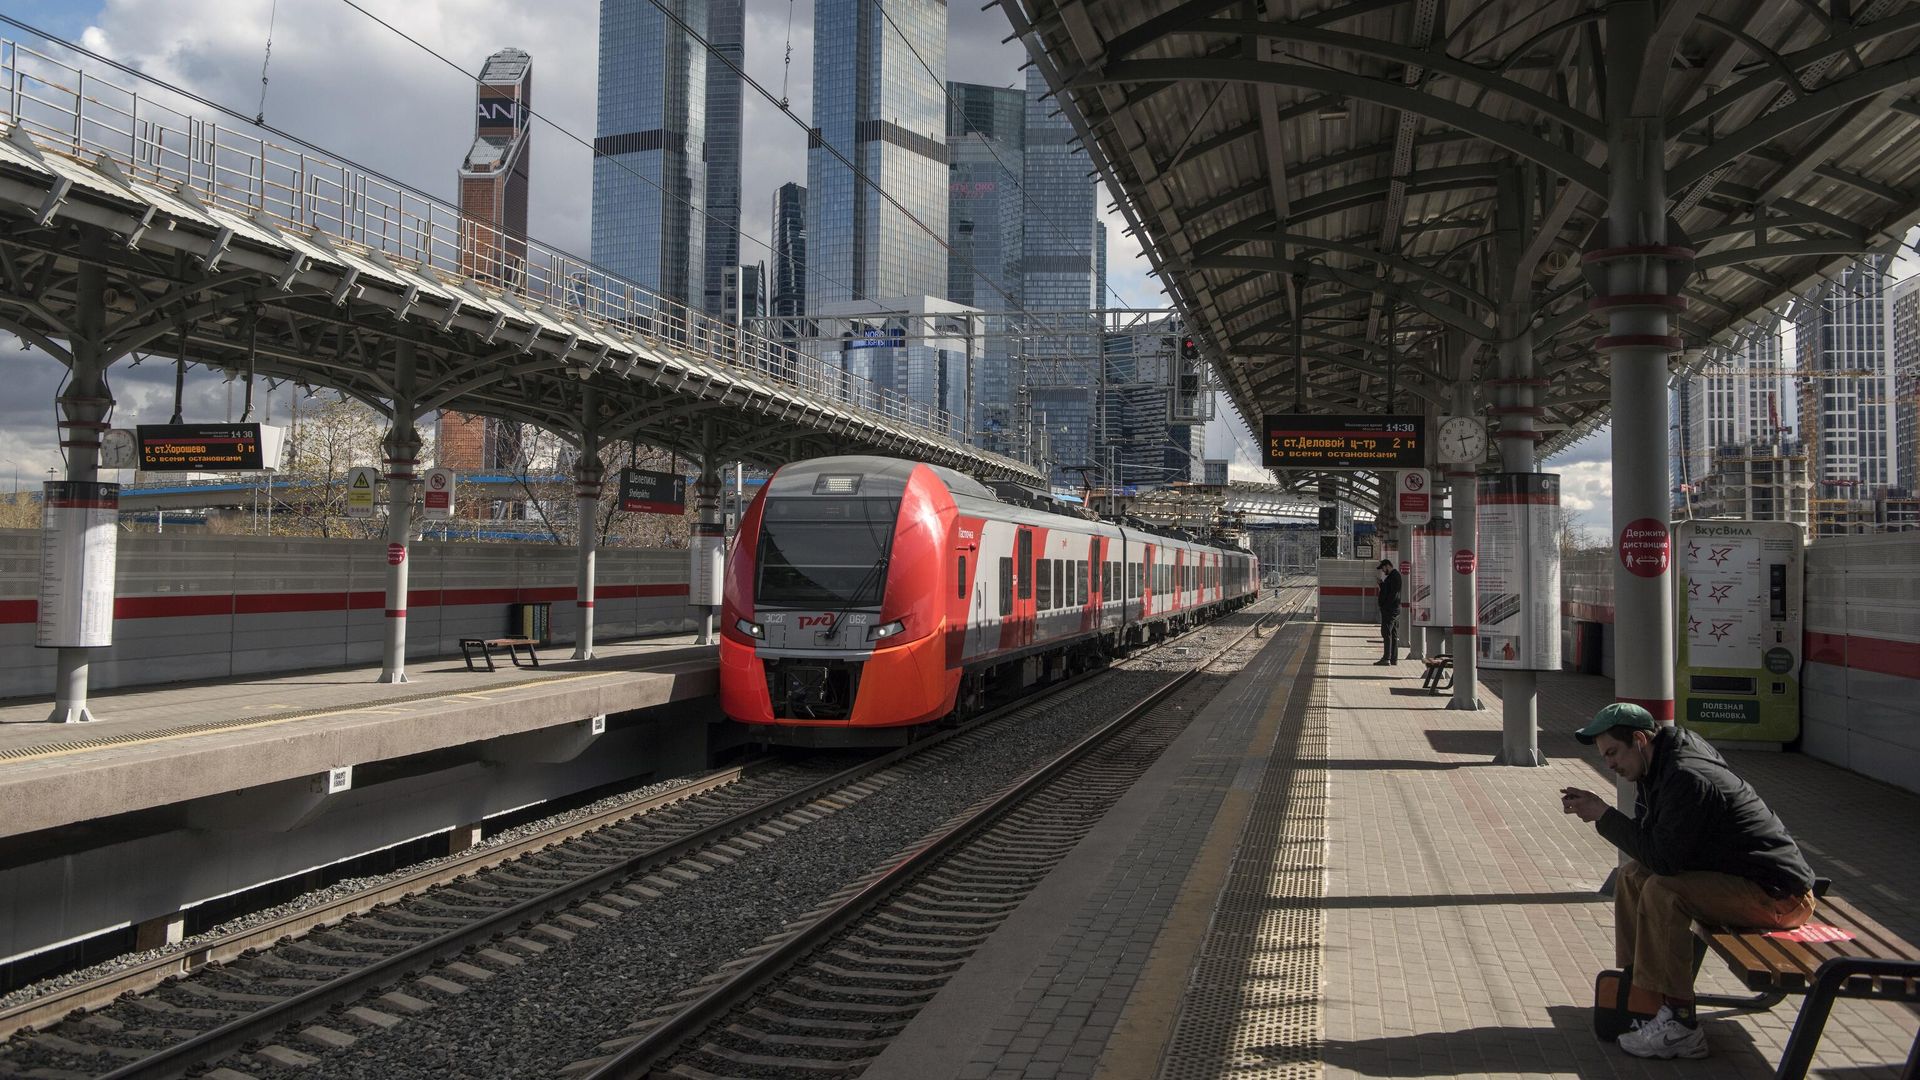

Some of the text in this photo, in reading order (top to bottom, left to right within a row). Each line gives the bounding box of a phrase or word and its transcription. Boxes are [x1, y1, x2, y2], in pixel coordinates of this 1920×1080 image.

[1386, 424, 1414, 432] 14:30
[1393, 438, 1400, 448] 2
[238, 443, 244, 453] 0
[1626, 529, 1666, 538] Держите
[1695, 526, 1752, 536] ВкусВилл
[850, 615, 867, 624] 062
[1702, 702, 1744, 711] ПОЛЕЗНАЯ
[1700, 711, 1746, 719] ОСТАНОВКА
